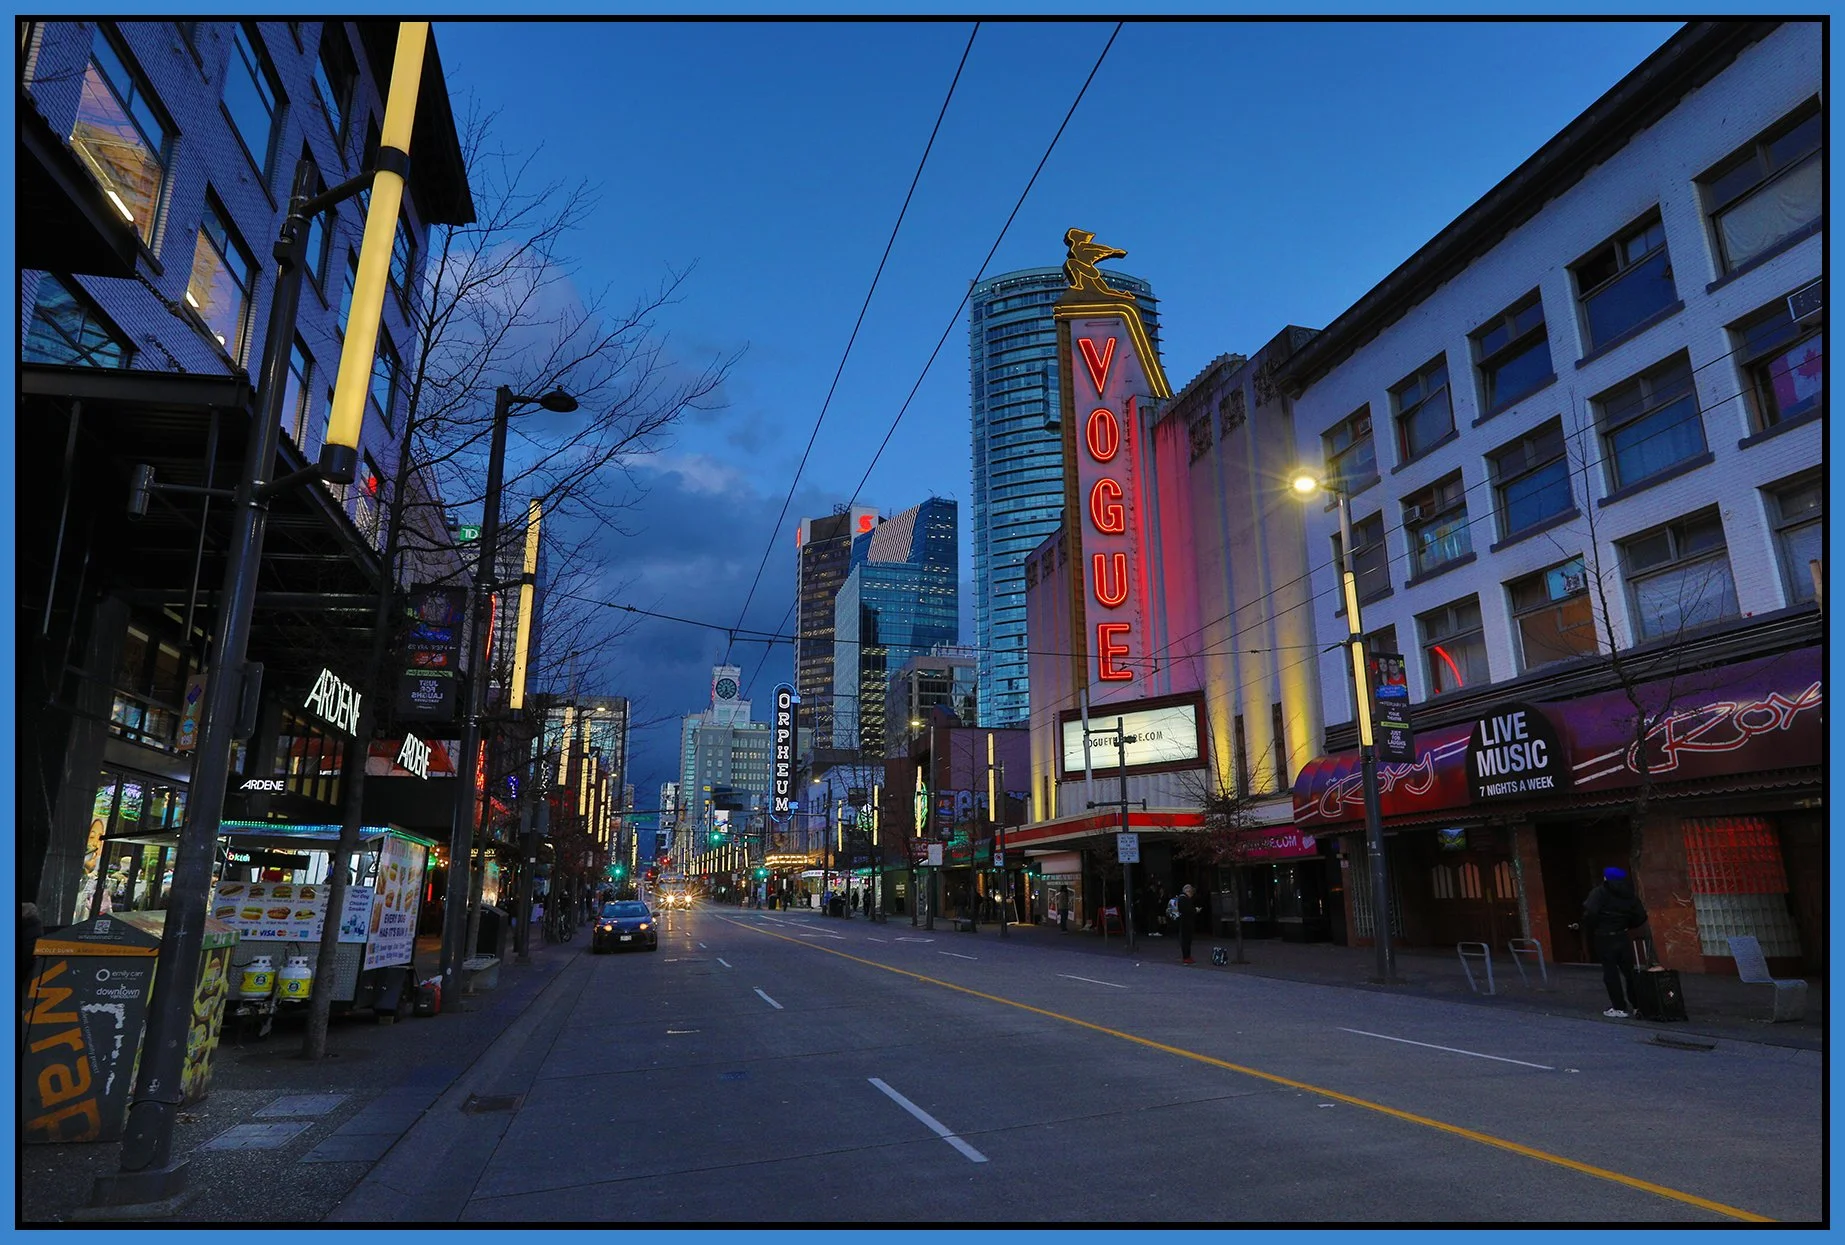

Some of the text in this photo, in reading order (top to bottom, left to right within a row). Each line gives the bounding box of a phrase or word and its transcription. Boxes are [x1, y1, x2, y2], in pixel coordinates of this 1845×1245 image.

[1077, 337, 1134, 682] VOGUE
[462, 528, 479, 539] TD
[1480, 711, 1529, 747] LIVE
[1627, 681, 1822, 774] Rox
[396, 732, 432, 781] ARDENE
[775, 692, 791, 812] ORPHEUM
[1476, 739, 1548, 777] MUSIC
[240, 779, 285, 791] ARDENE
[1479, 776, 1554, 797] 7 NIGHTS A WEEK
[384, 913, 406, 924] EVERY DOG
[96, 983, 140, 996] downtown
[111, 969, 130, 978] emily
[22, 960, 100, 1144] wrap
